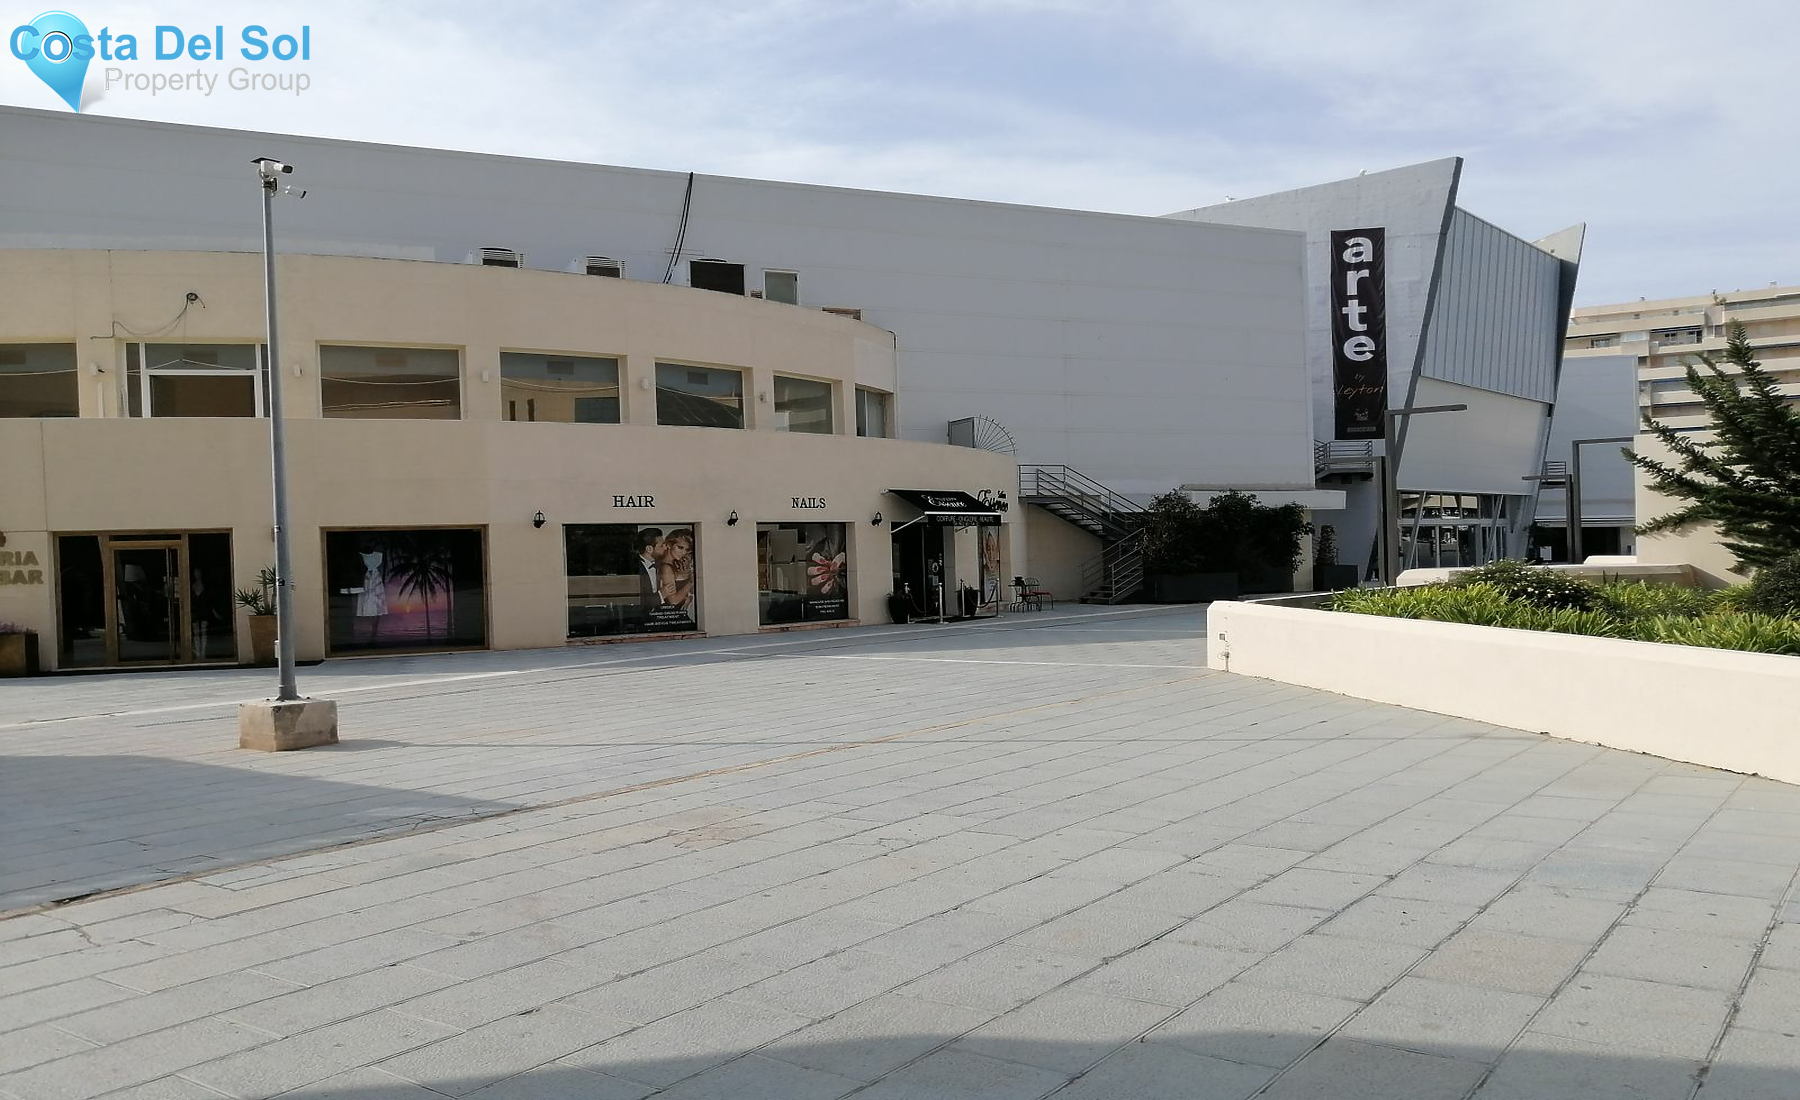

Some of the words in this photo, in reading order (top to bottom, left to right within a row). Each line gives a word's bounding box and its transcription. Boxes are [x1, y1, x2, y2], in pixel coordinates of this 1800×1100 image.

[1342, 237, 1376, 362] arte
[612, 495, 655, 508] HAIR
[791, 497, 827, 509] NAILS
